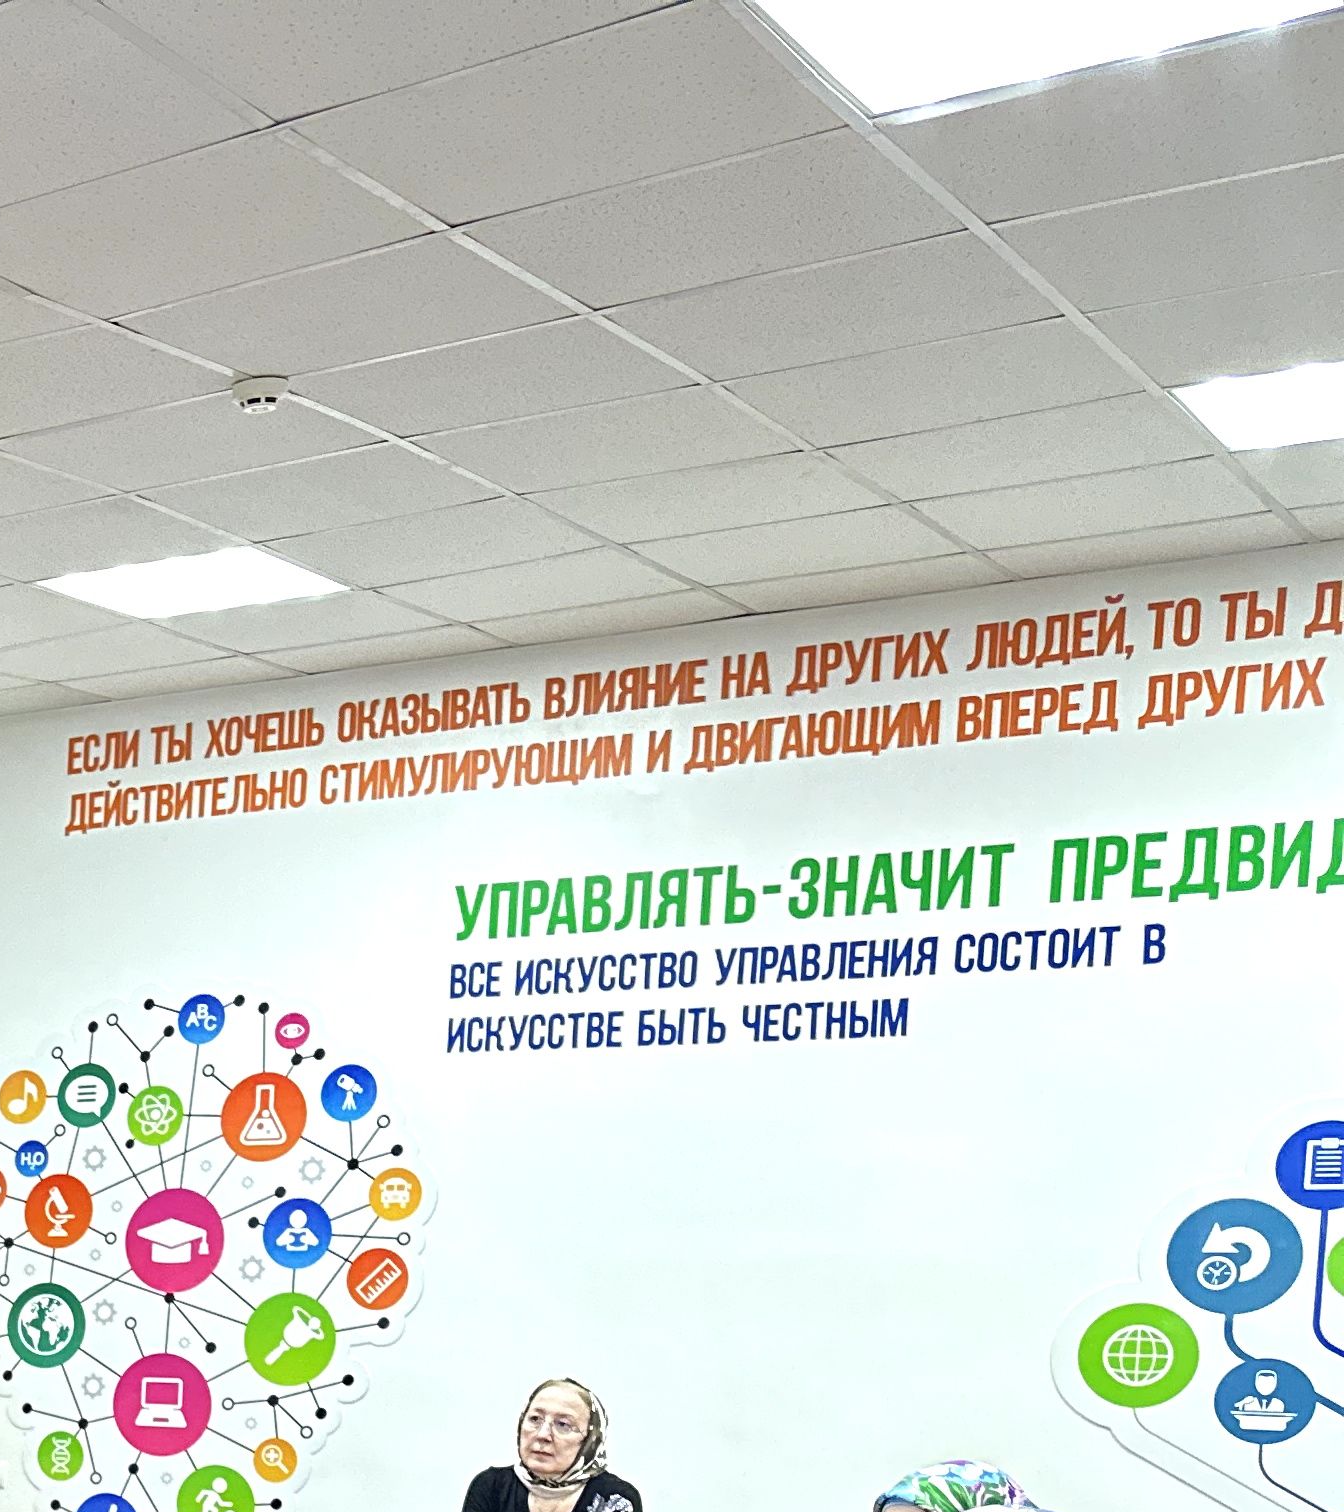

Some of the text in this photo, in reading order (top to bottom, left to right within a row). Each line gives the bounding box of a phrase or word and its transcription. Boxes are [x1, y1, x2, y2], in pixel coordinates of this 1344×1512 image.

[67, 730, 139, 775] ЕСЛИ
[150, 722, 193, 765] ТЫ
[204, 707, 325, 759] ХОЧЕШЬ
[337, 682, 531, 743] ОКАЗЫВАТЬ
[543, 659, 708, 720] ВЛИЯНИЕ
[721, 651, 771, 700] НА
[786, 628, 950, 697] ДРУГИХ
[966, 593, 1134, 671] ЛЮДЕЙ,
[1148, 597, 1201, 650] ТО
[1220, 587, 1287, 642] ТЫ
[64, 657, 1326, 836] ДЕЙСТВИТЕЛЬНО СТИМУЛИРУЮЩИМ И ДВИГАЮЩИМ ВПЕРЕД ДРУГИХ
[454, 843, 1015, 941] УПРАВЛЯТЬ-ЗНАЧИТ
[449, 923, 1166, 999] ВСЕ ИСКУССТВО УПРАВЛЕНИЯ СОСТОИТ В
[185, 1003, 217, 1032] ABC
[447, 998, 910, 1054] ИСКУССТВЕ БЫТЬ ЧЕСТНЫМ
